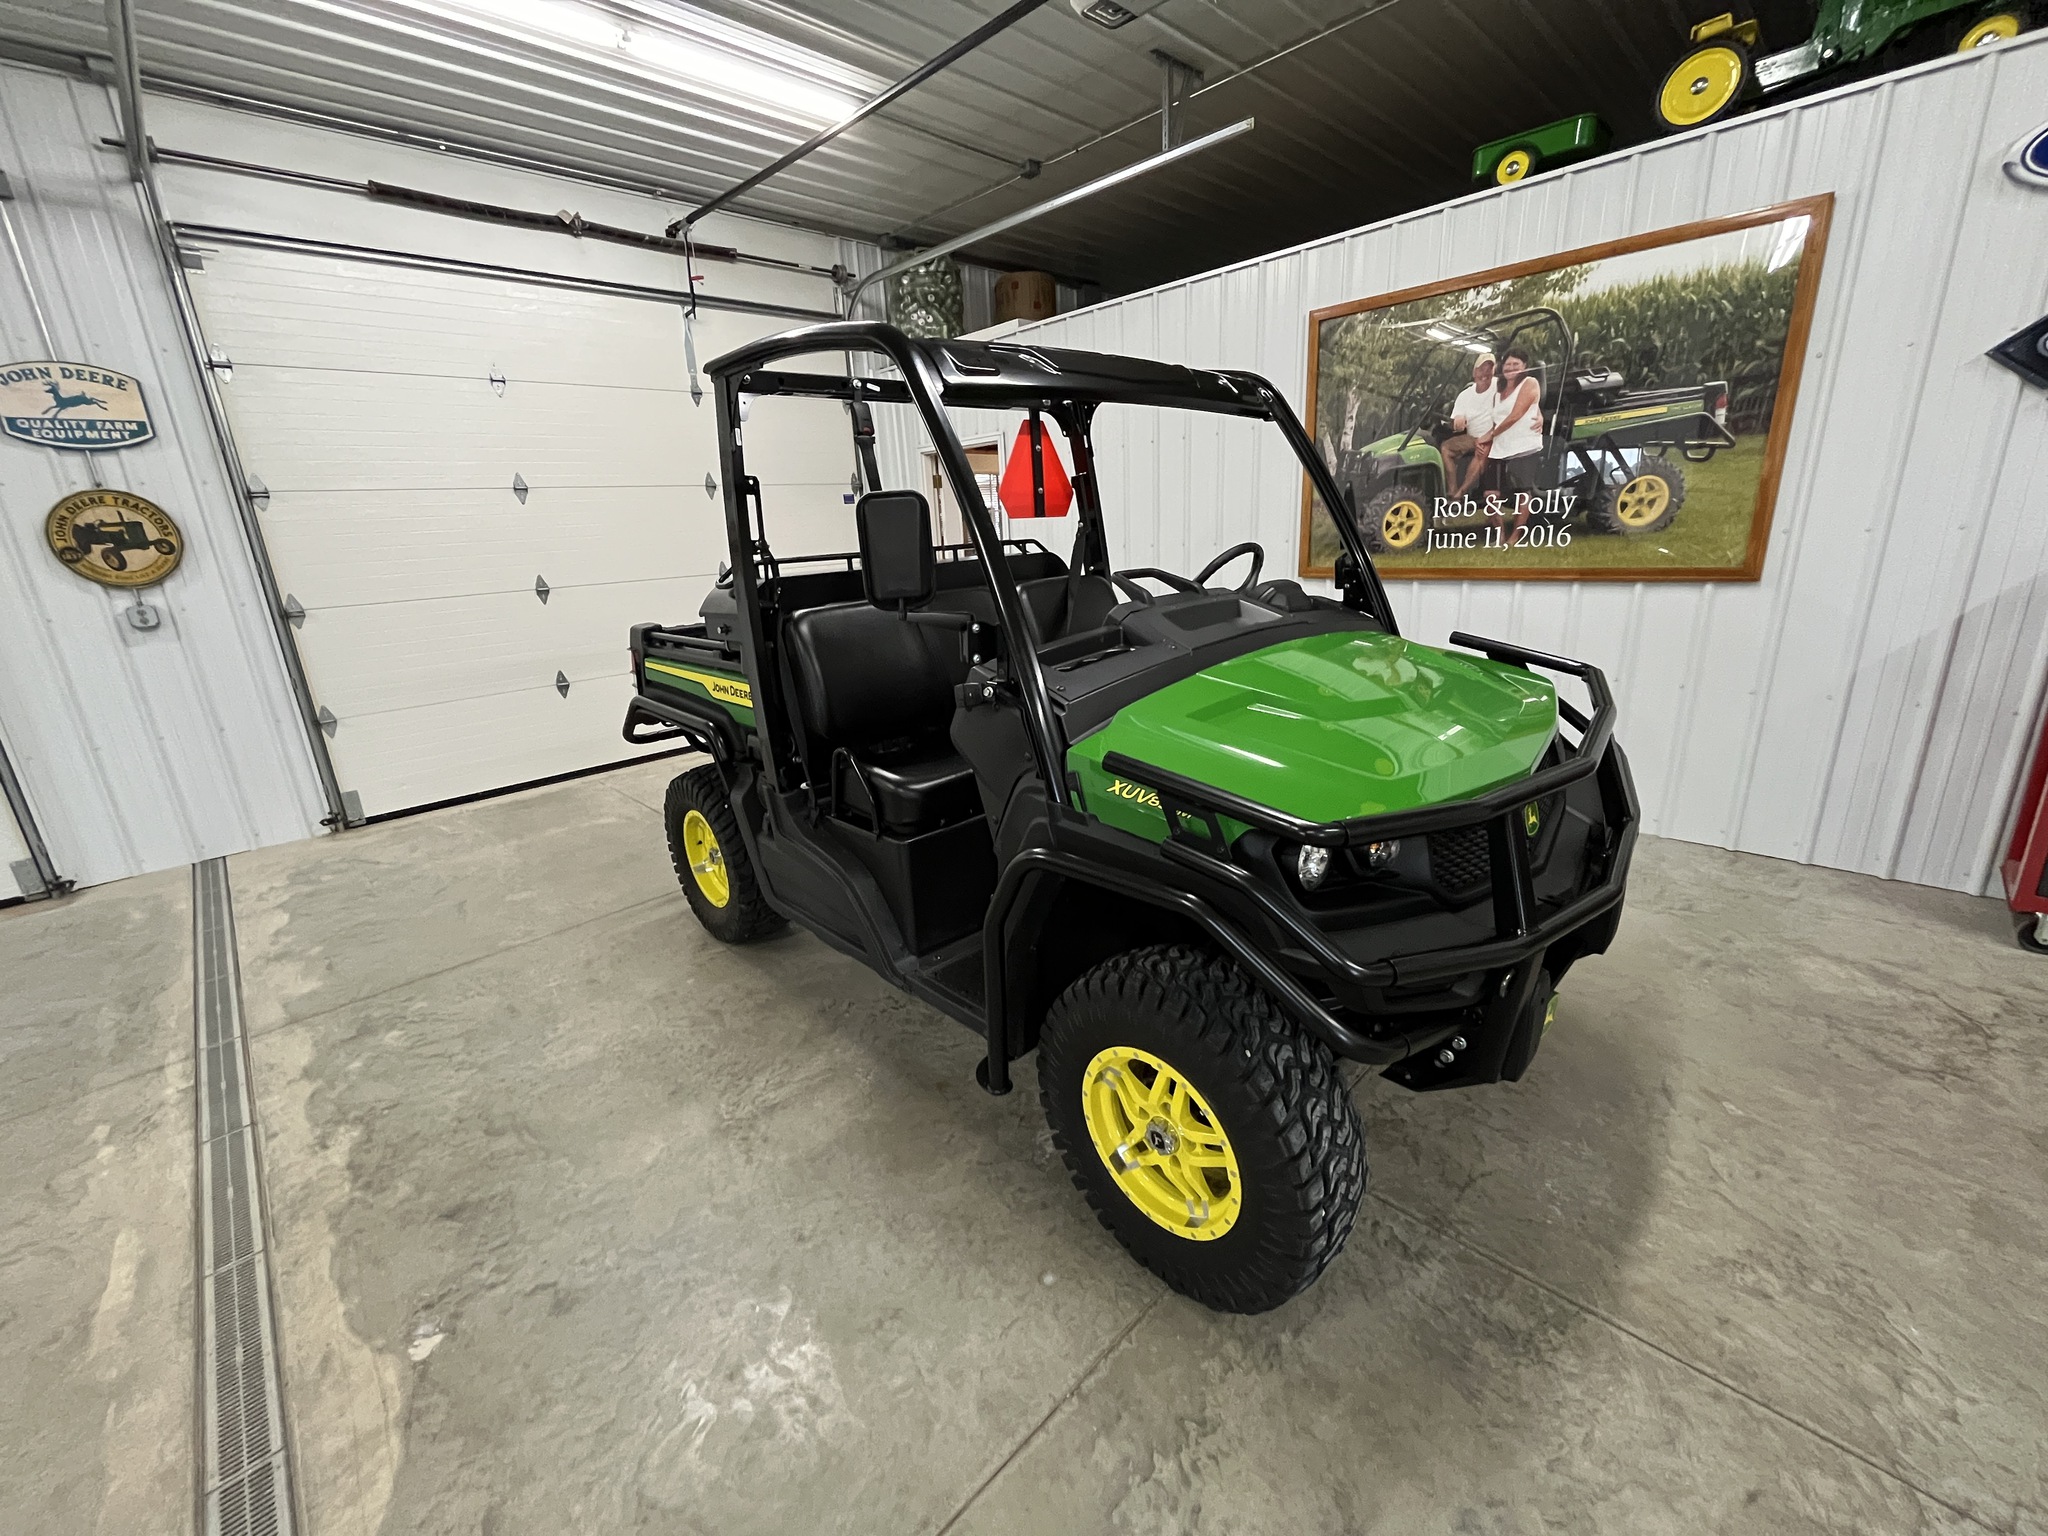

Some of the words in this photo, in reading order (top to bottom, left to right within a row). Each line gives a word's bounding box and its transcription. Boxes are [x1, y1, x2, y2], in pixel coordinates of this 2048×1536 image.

[0, 366, 52, 386] JOHN
[59, 366, 129, 391] DEERE
[16, 418, 88, 429] QUALITY
[96, 421, 138, 431] FARM
[31, 429, 130, 440] EQUIPMENT
[1432, 493, 1478, 519] Rob
[1483, 493, 1508, 517] &
[1511, 488, 1578, 520] Polly
[55, 513, 69, 543] JOHN
[65, 495, 106, 516] DEERE
[111, 496, 173, 538] TRACTORS
[1425, 528, 1478, 555] June
[1483, 526, 1510, 552] 11,
[1513, 523, 1573, 549] 2016
[712, 681, 730, 696] JOHN
